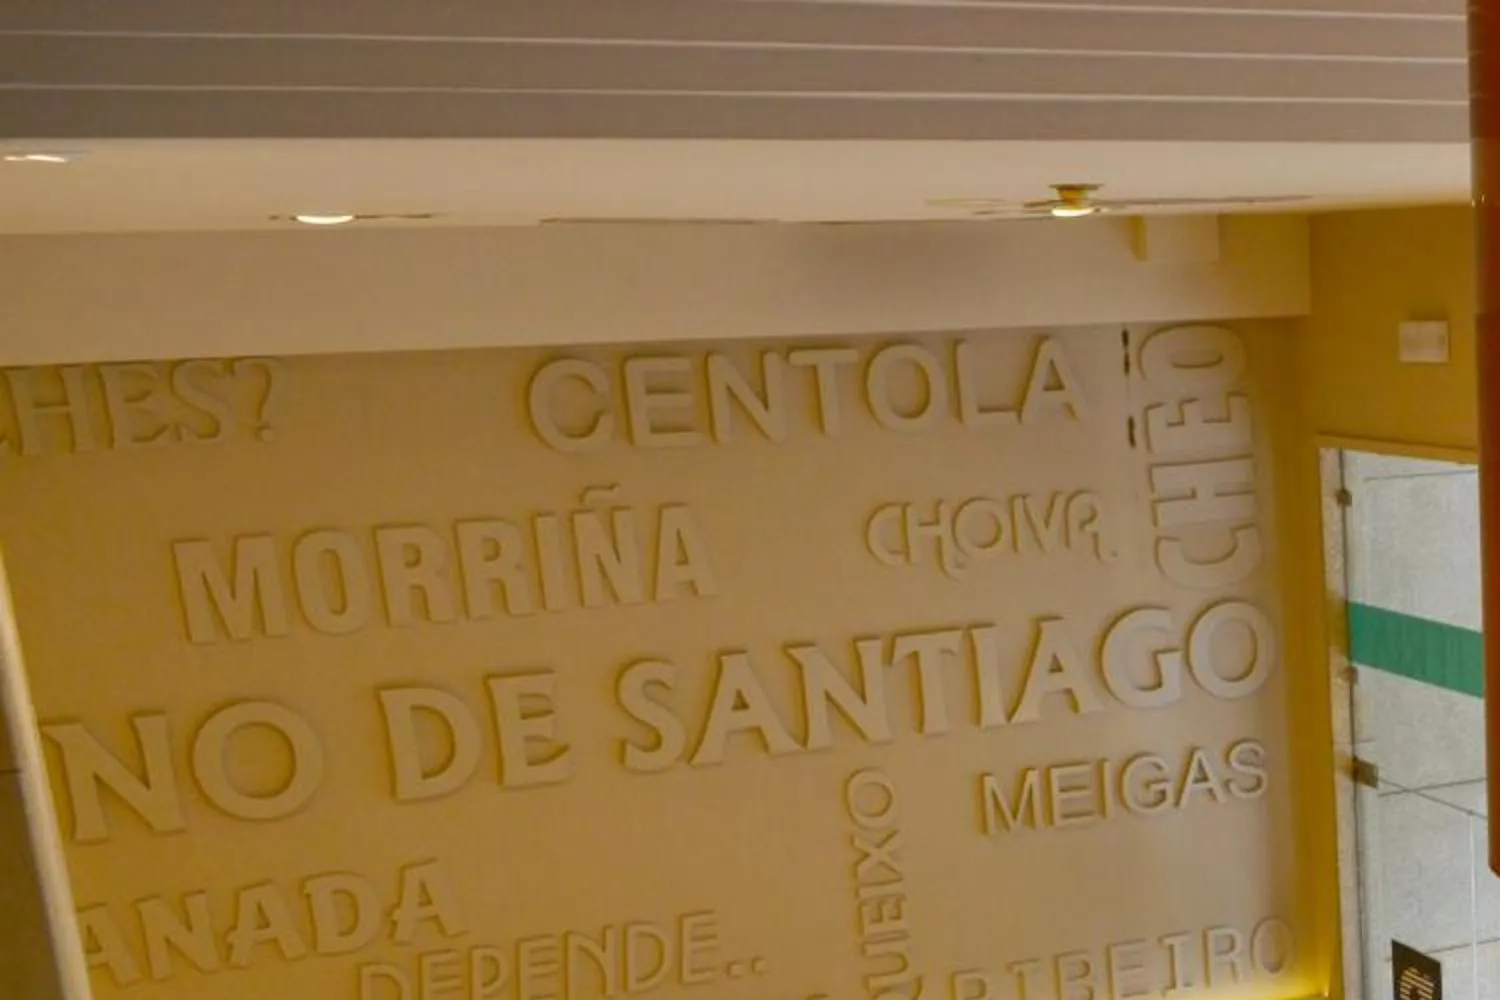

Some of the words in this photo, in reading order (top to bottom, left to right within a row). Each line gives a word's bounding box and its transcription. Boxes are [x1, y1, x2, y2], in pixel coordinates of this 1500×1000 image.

[0, 358, 282, 456] HES?
[527, 337, 1083, 452] CENTOLA
[1137, 322, 1263, 590] CHEO
[172, 482, 717, 645] MORRIÑA
[39, 697, 325, 845] NO
[374, 669, 572, 803] DE
[613, 598, 1276, 772] SANTIAGO
[976, 738, 1268, 837] MEIGAS
